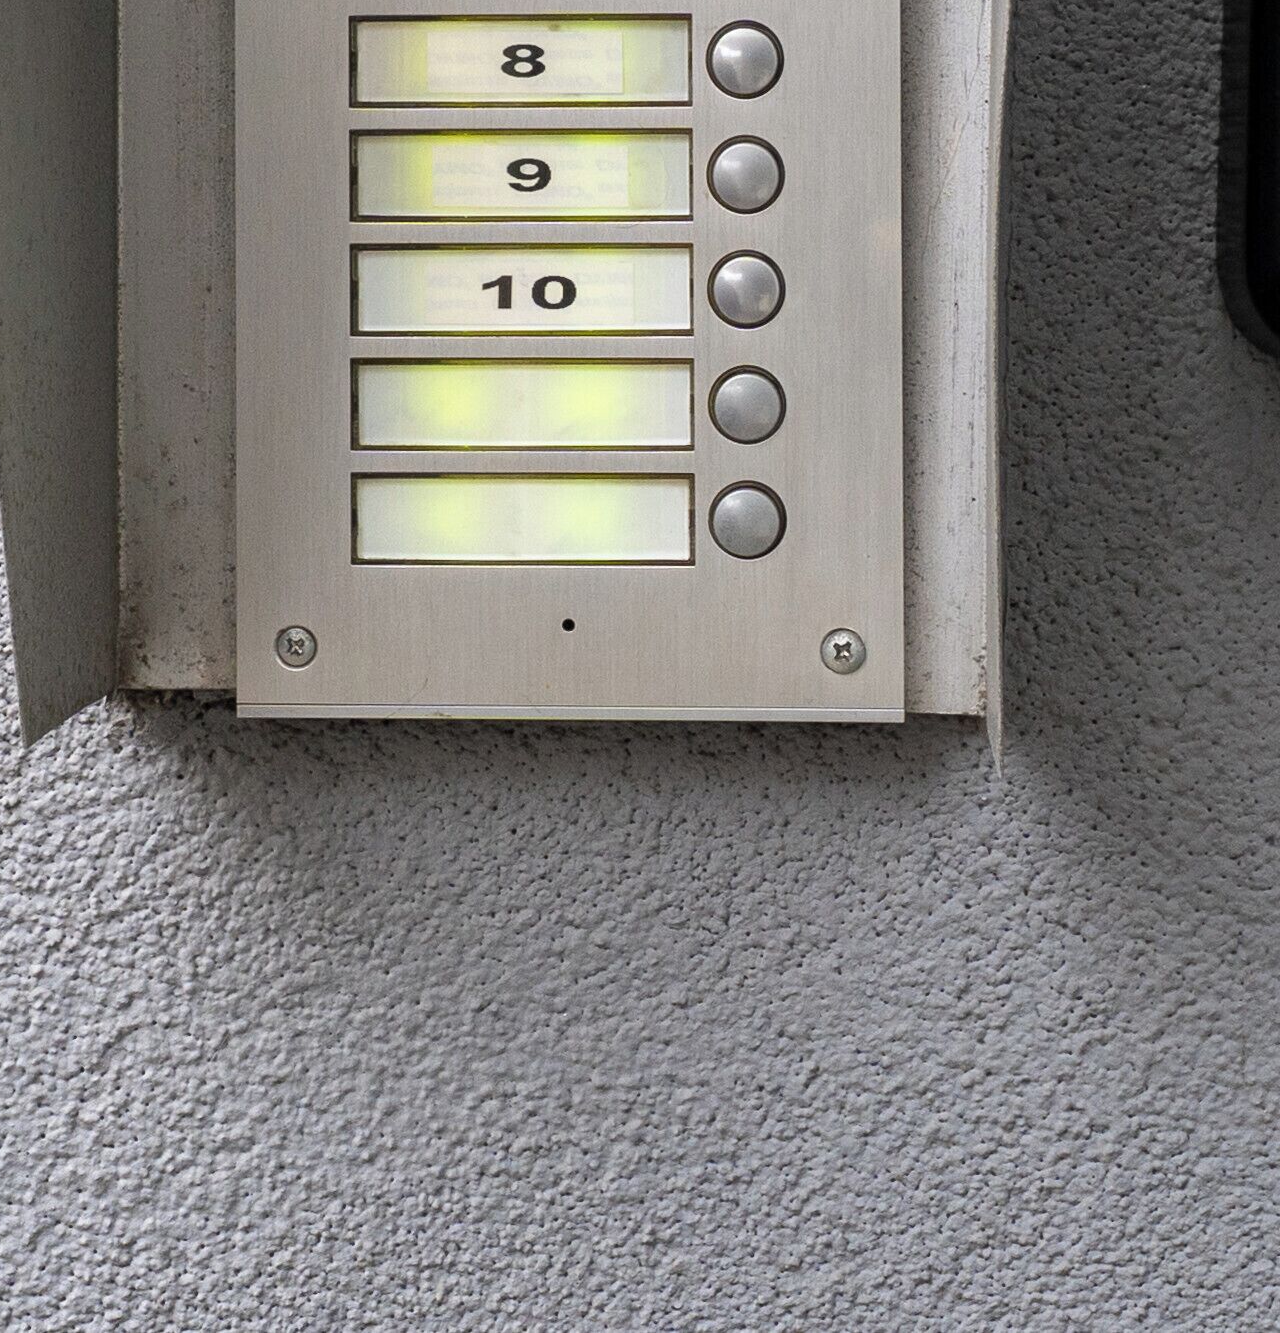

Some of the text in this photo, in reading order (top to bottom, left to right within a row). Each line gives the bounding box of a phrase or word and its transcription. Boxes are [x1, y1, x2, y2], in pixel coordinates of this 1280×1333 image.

[500, 43, 547, 79] 8
[505, 157, 552, 193] 9
[480, 274, 578, 311] 10
